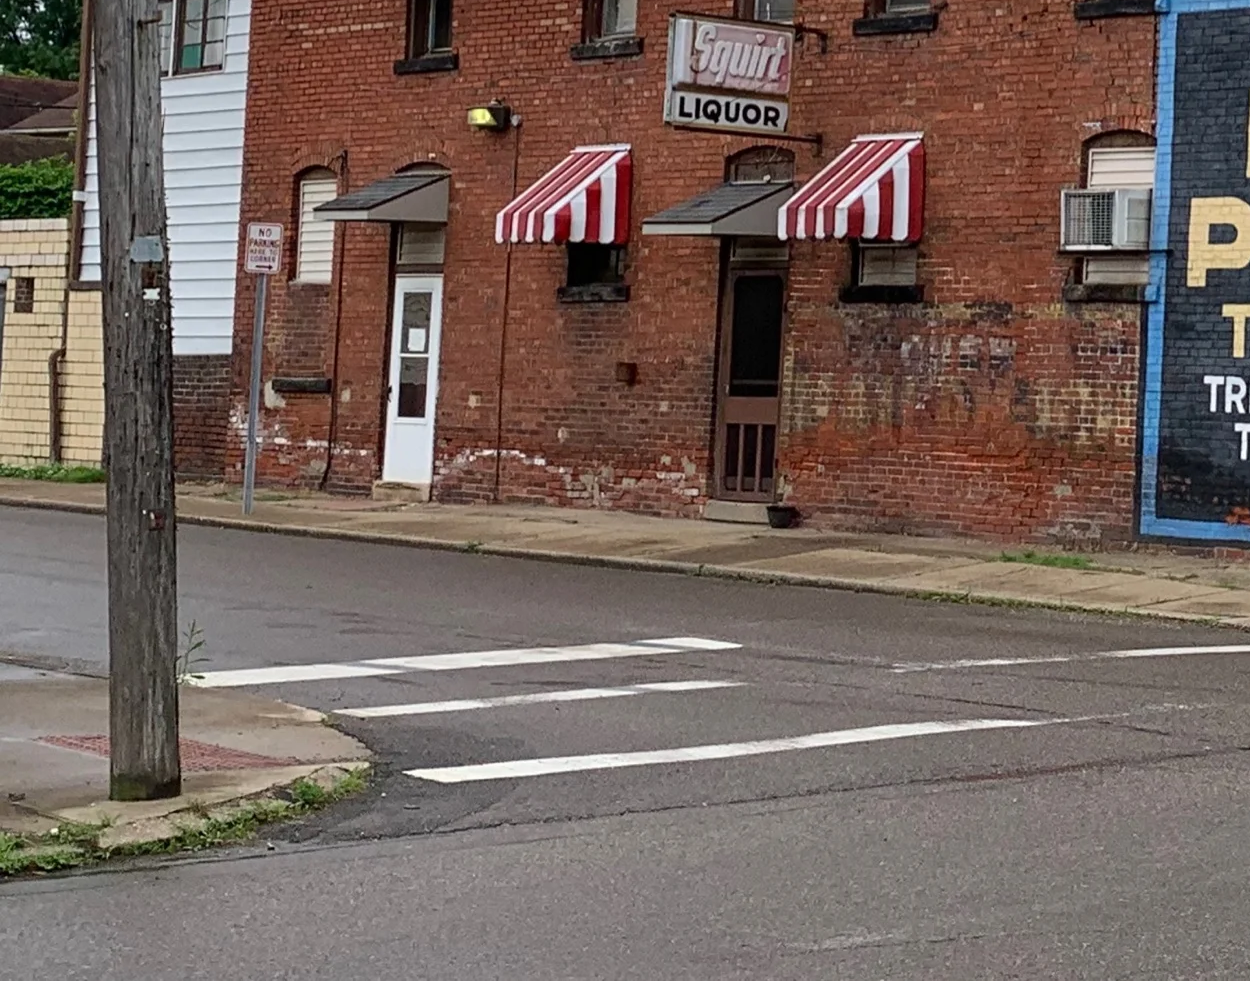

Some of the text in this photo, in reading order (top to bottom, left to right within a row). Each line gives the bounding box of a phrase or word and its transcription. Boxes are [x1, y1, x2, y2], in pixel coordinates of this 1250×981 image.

[691, 24, 787, 84] Squirt
[678, 96, 780, 128] LIQUOR
[249, 238, 280, 248] PARKING
[258, 228, 272, 237] NO
